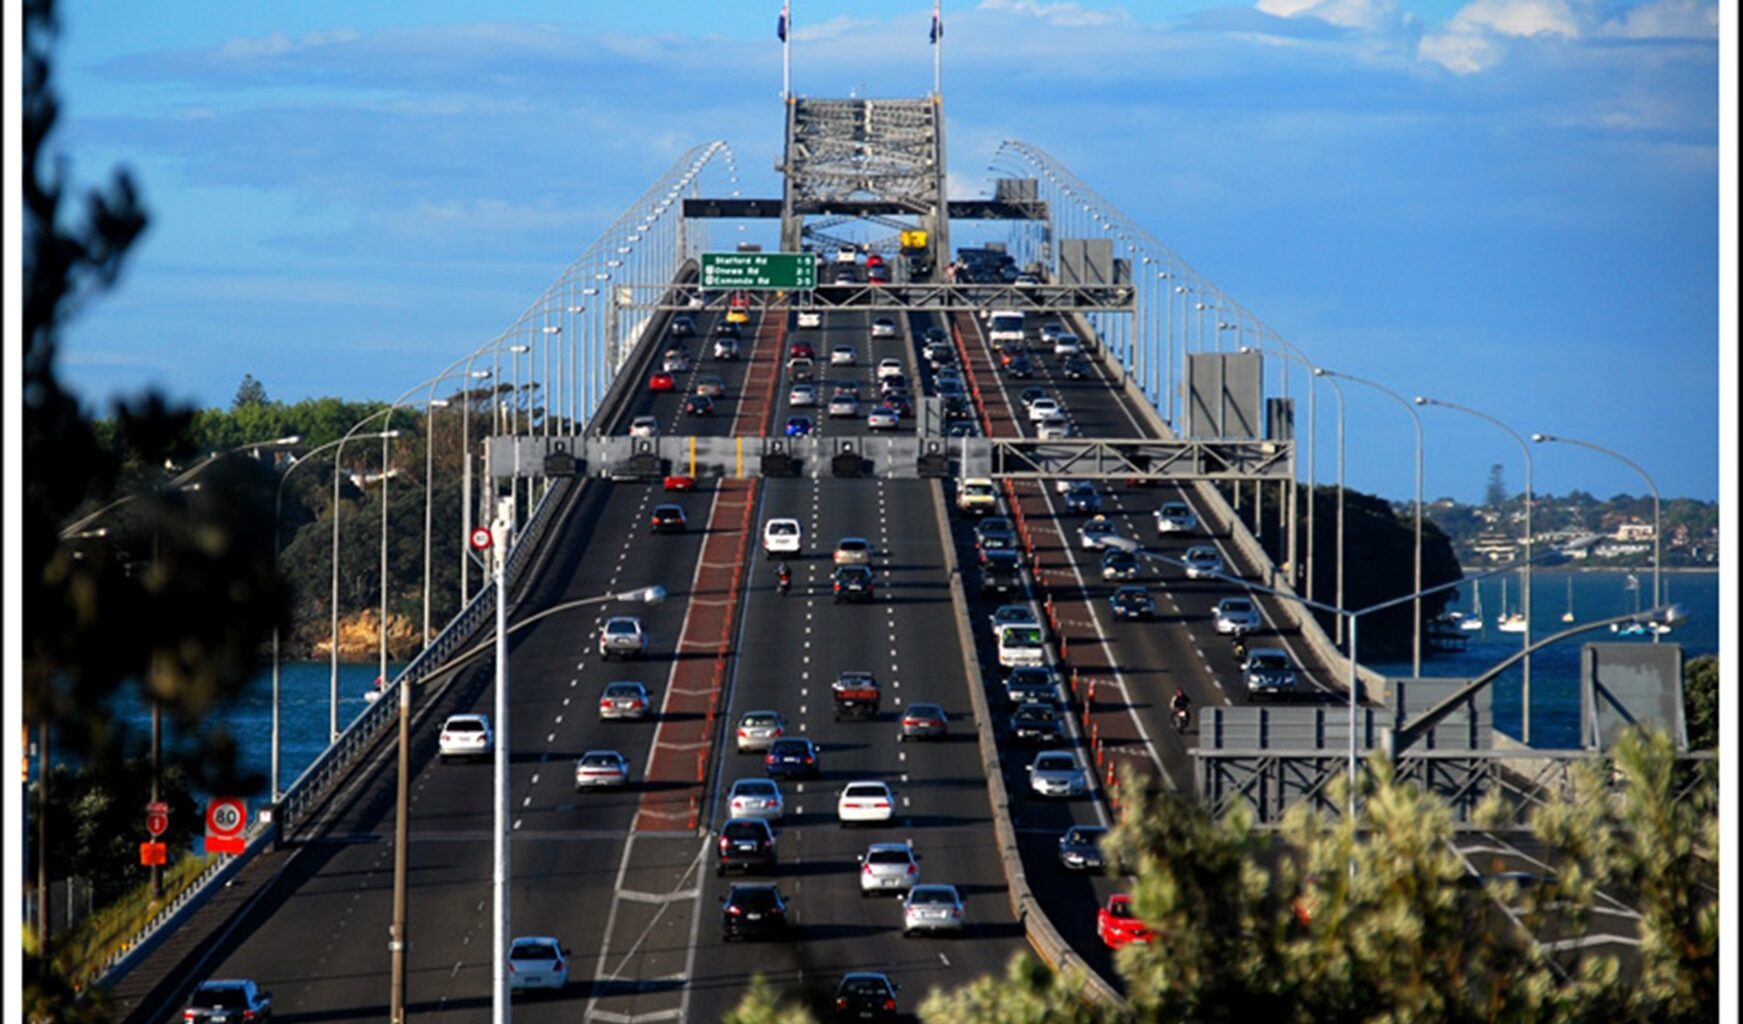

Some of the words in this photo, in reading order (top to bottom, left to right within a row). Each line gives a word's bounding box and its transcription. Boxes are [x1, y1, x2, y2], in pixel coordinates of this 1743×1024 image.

[755, 256, 768, 265] Rd
[747, 266, 760, 275] Rd
[757, 276, 770, 285] Rd
[216, 809, 236, 825] 80
